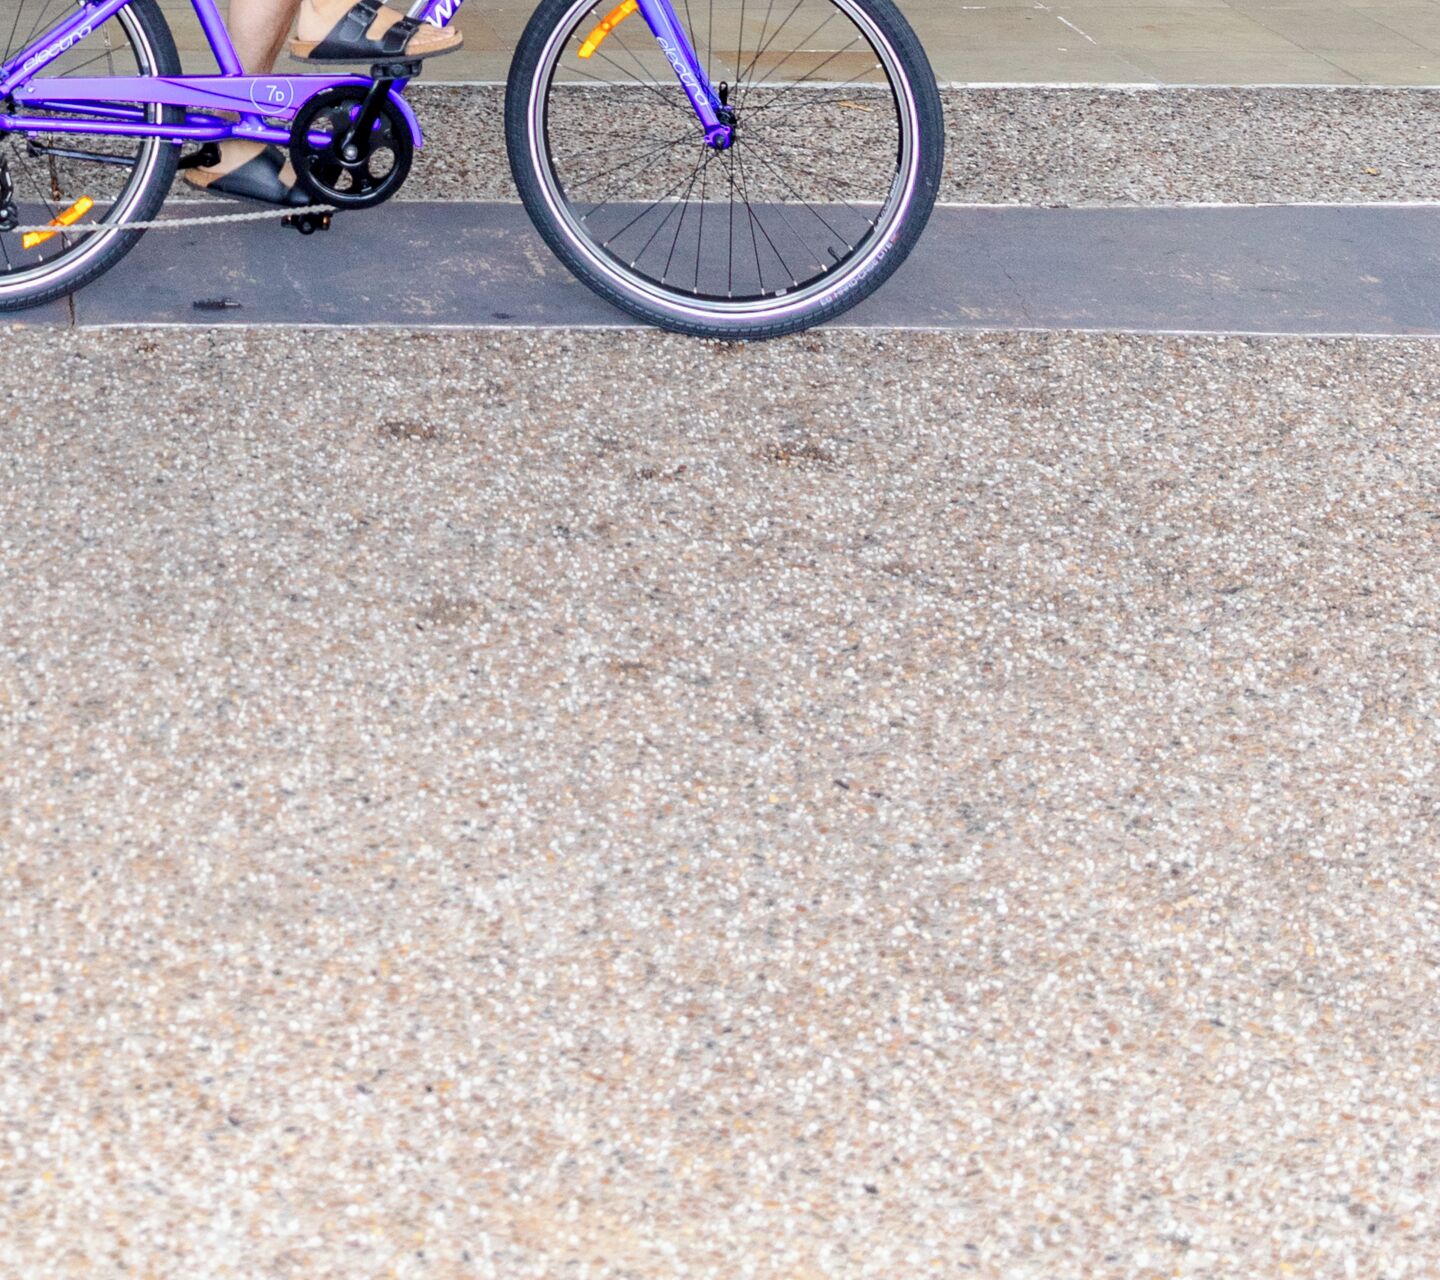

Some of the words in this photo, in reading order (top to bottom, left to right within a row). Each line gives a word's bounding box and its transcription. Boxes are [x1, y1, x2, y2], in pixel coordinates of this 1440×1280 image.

[22, 24, 92, 71] electra
[655, 36, 708, 106] electra
[265, 84, 285, 102] 7D
